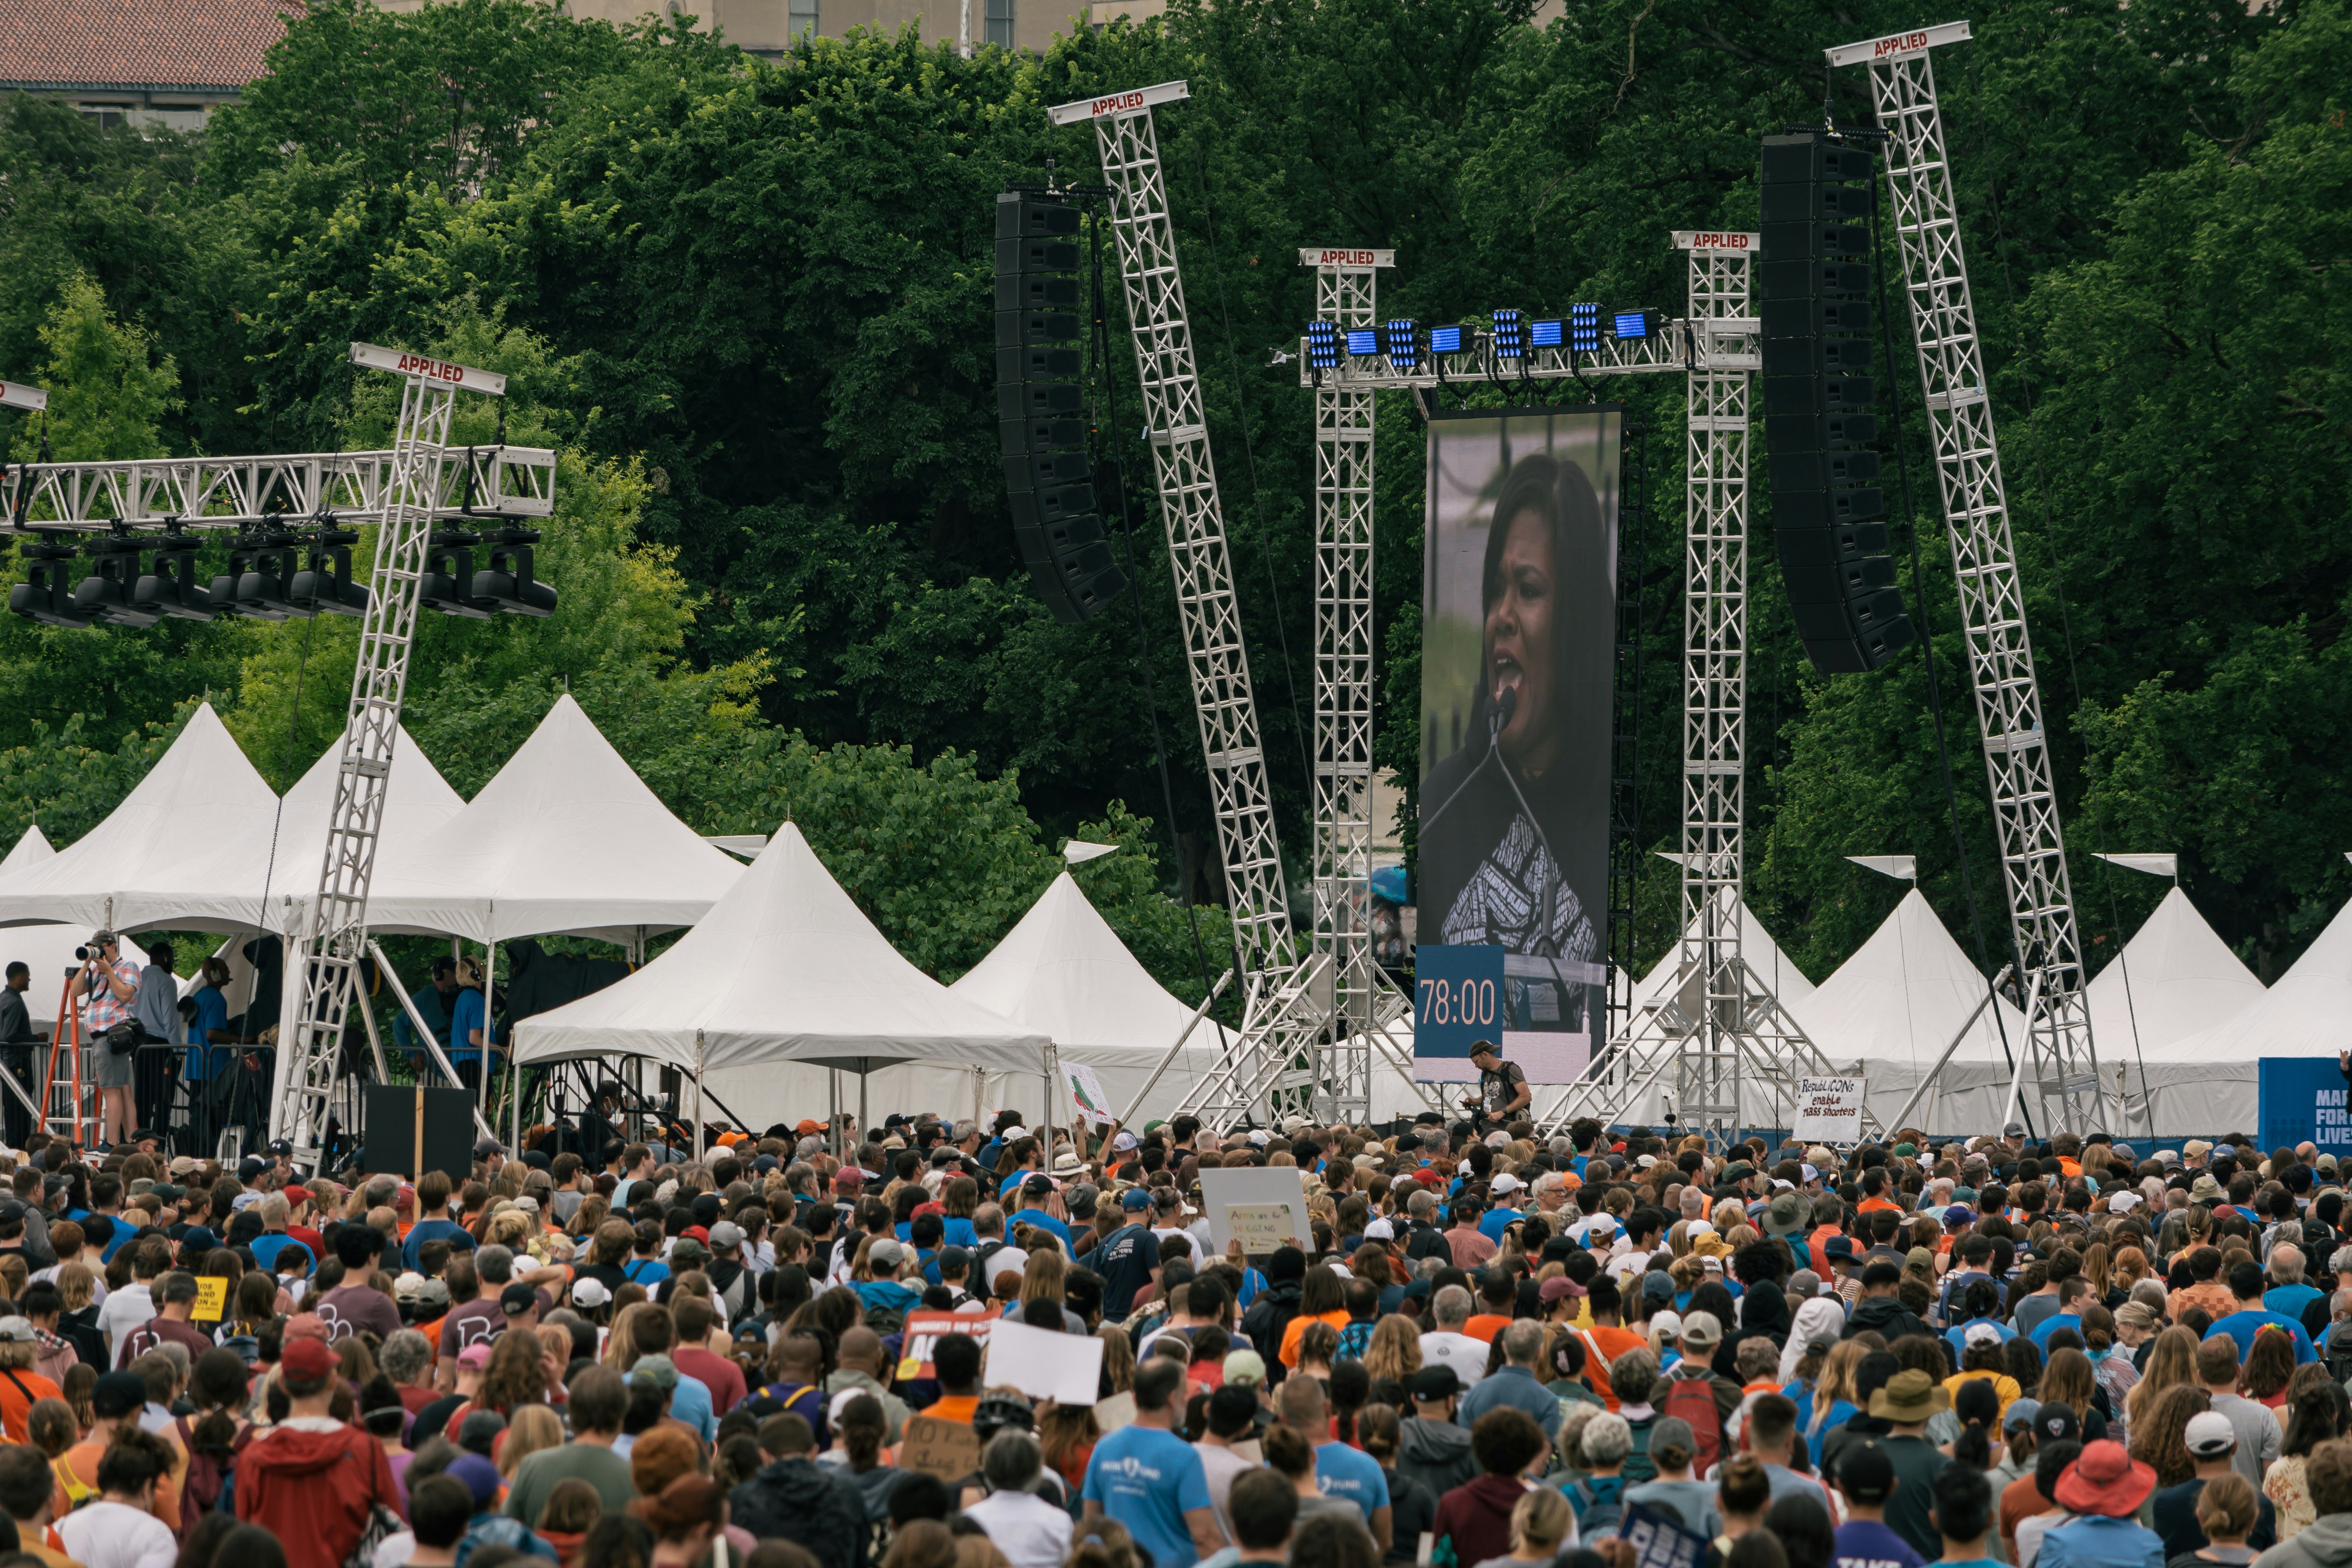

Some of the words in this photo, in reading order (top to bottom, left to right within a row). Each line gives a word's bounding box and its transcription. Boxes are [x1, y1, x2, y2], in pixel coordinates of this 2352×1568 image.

[1875, 33, 1927, 56] APPLIED
[1092, 93, 1144, 115] APPLIED
[1693, 233, 1748, 248] APPLIED
[1320, 250, 1374, 264] APPLIED
[397, 354, 464, 382] APPLIED
[1420, 979, 1495, 1025] 78:00
[1822, 1104, 1857, 1117] shooters
[2316, 1109, 2348, 1125] FOR
[1231, 1210, 1255, 1220] Arms
